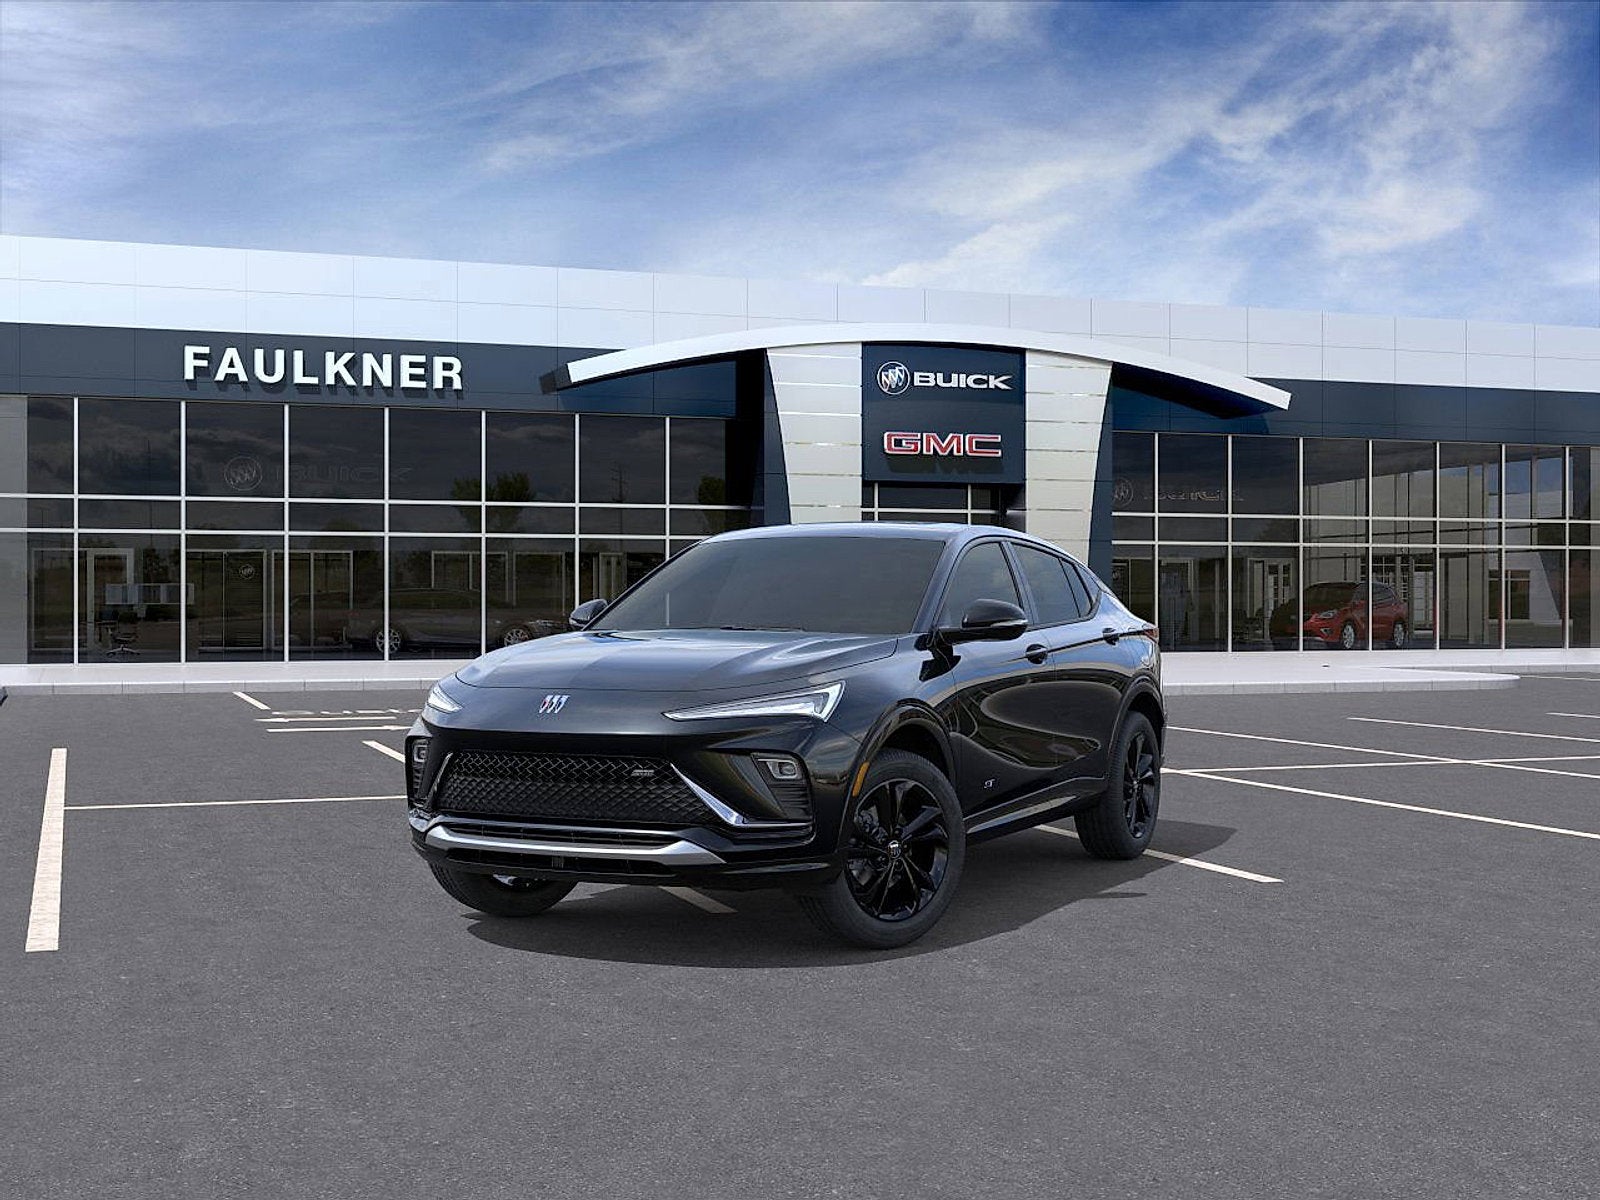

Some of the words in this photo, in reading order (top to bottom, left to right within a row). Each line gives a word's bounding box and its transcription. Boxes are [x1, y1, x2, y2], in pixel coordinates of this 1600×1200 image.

[183, 345, 463, 390] FAULKNER
[913, 371, 1013, 390] BUICK
[883, 431, 1002, 458] GMC
